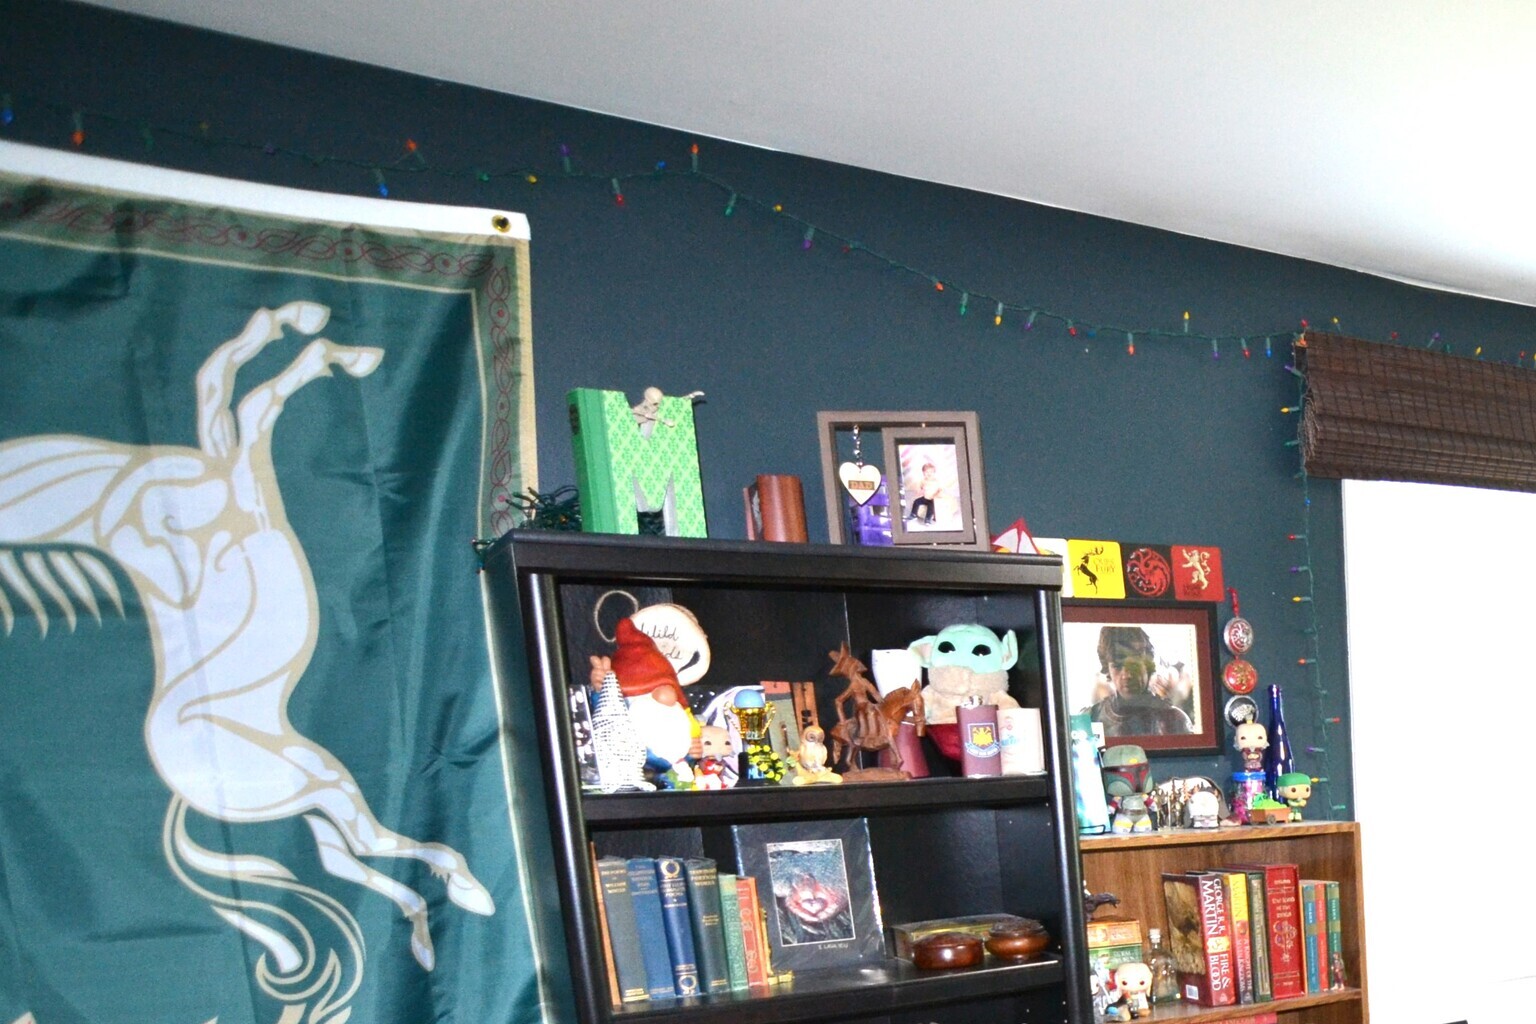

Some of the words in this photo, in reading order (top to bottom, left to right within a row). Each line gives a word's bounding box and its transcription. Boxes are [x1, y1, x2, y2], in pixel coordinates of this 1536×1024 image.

[1202, 879, 1218, 935] MARTIN
[1213, 878, 1224, 914] GEORGE
[1209, 955, 1222, 991] BLOOD
[1220, 953, 1231, 974] FIRE
[1222, 976, 1232, 989] &
